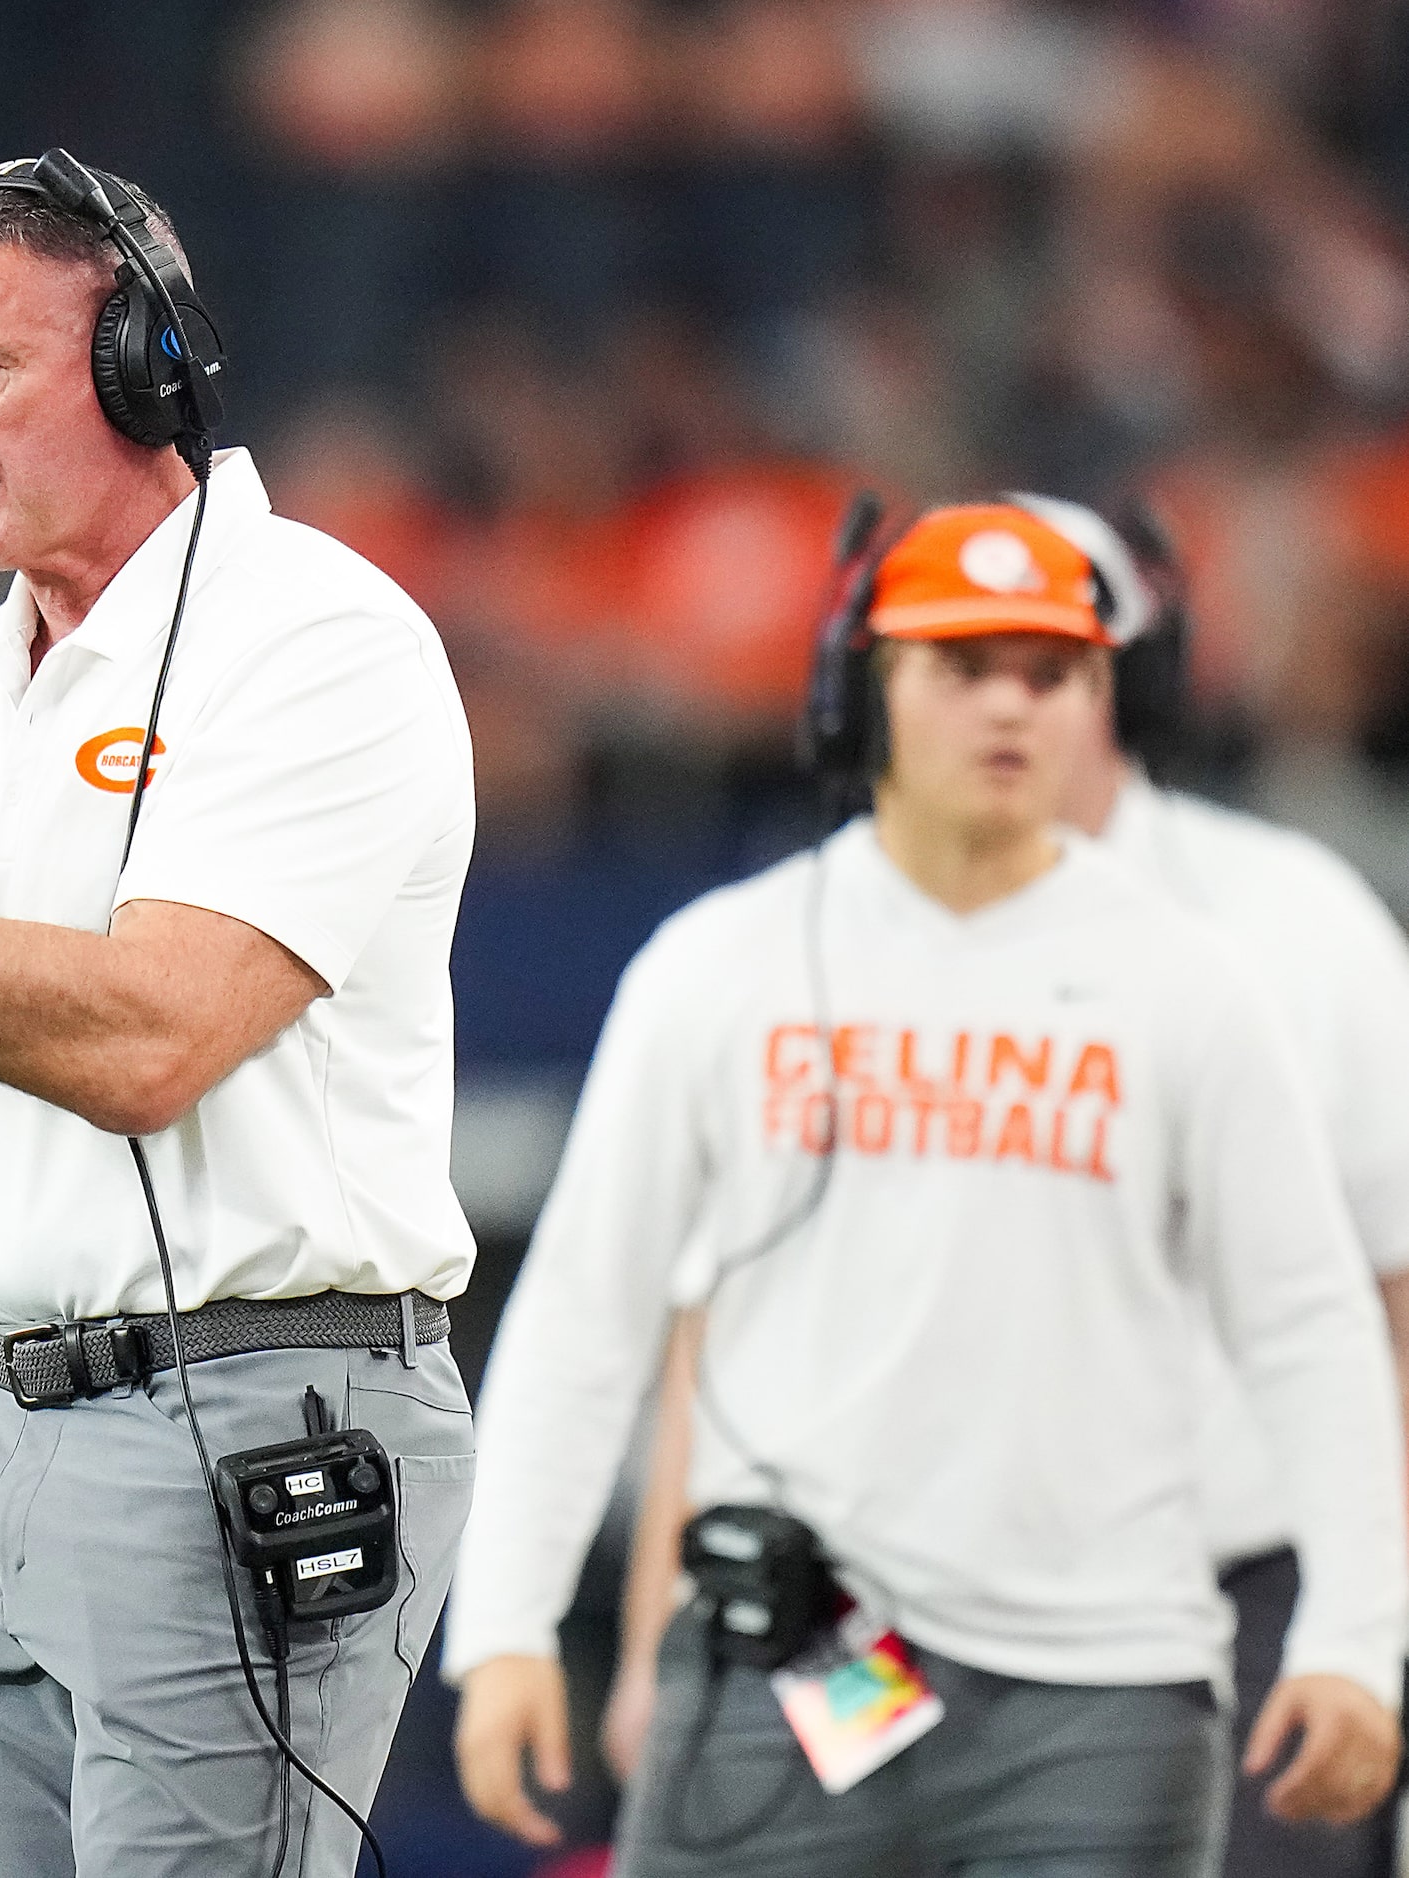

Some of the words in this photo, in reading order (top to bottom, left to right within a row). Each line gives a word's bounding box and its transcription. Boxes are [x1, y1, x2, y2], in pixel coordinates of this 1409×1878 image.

[765, 1023, 1121, 1107] CELINA
[763, 1094, 1115, 1184] FOOTBALL
[288, 1476, 321, 1491] HC
[276, 1500, 358, 1526] CoachComm
[300, 1552, 359, 1575] HSL7
